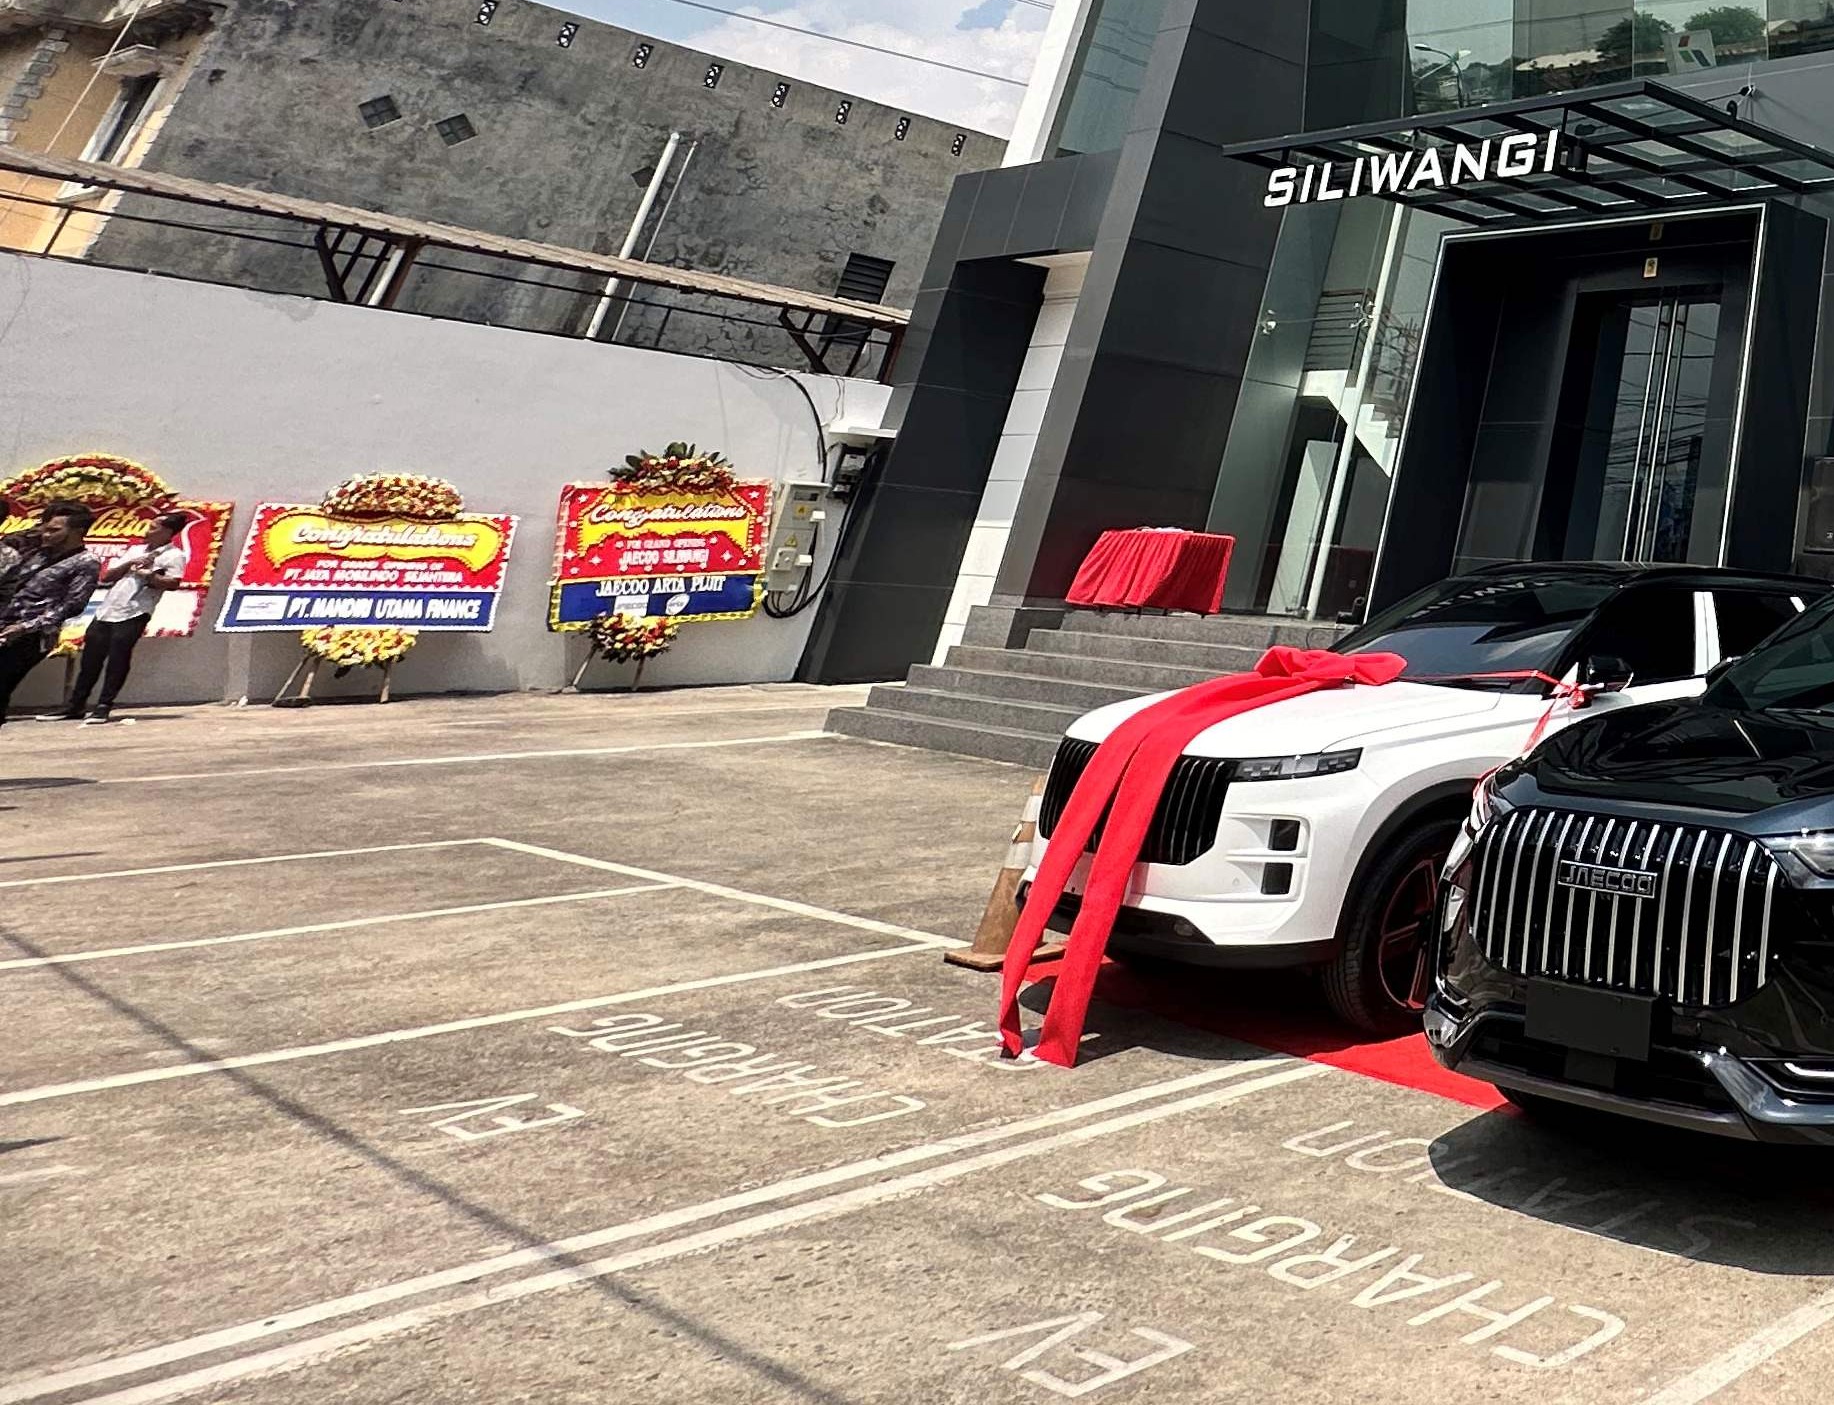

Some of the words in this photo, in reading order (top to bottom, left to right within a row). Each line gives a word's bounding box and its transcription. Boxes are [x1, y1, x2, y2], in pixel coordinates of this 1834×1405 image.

[1263, 129, 1559, 208] SILIWANGI
[590, 502, 748, 528] Congratulations
[292, 523, 479, 549] Congratulations
[619, 549, 660, 565] JAECOO
[595, 578, 650, 597] JAECOO
[652, 577, 686, 594] ARTA
[690, 575, 727, 593] PLUIT
[375, 598, 423, 620] UTAMA
[425, 598, 482, 620] FINANCE
[1561, 864, 1653, 895] JAECOO
[547, 1012, 926, 1129] CHARGING
[400, 1093, 586, 1142] EV
[1035, 1167, 1627, 1369] CHARGING
[945, 1310, 1196, 1397] EV
